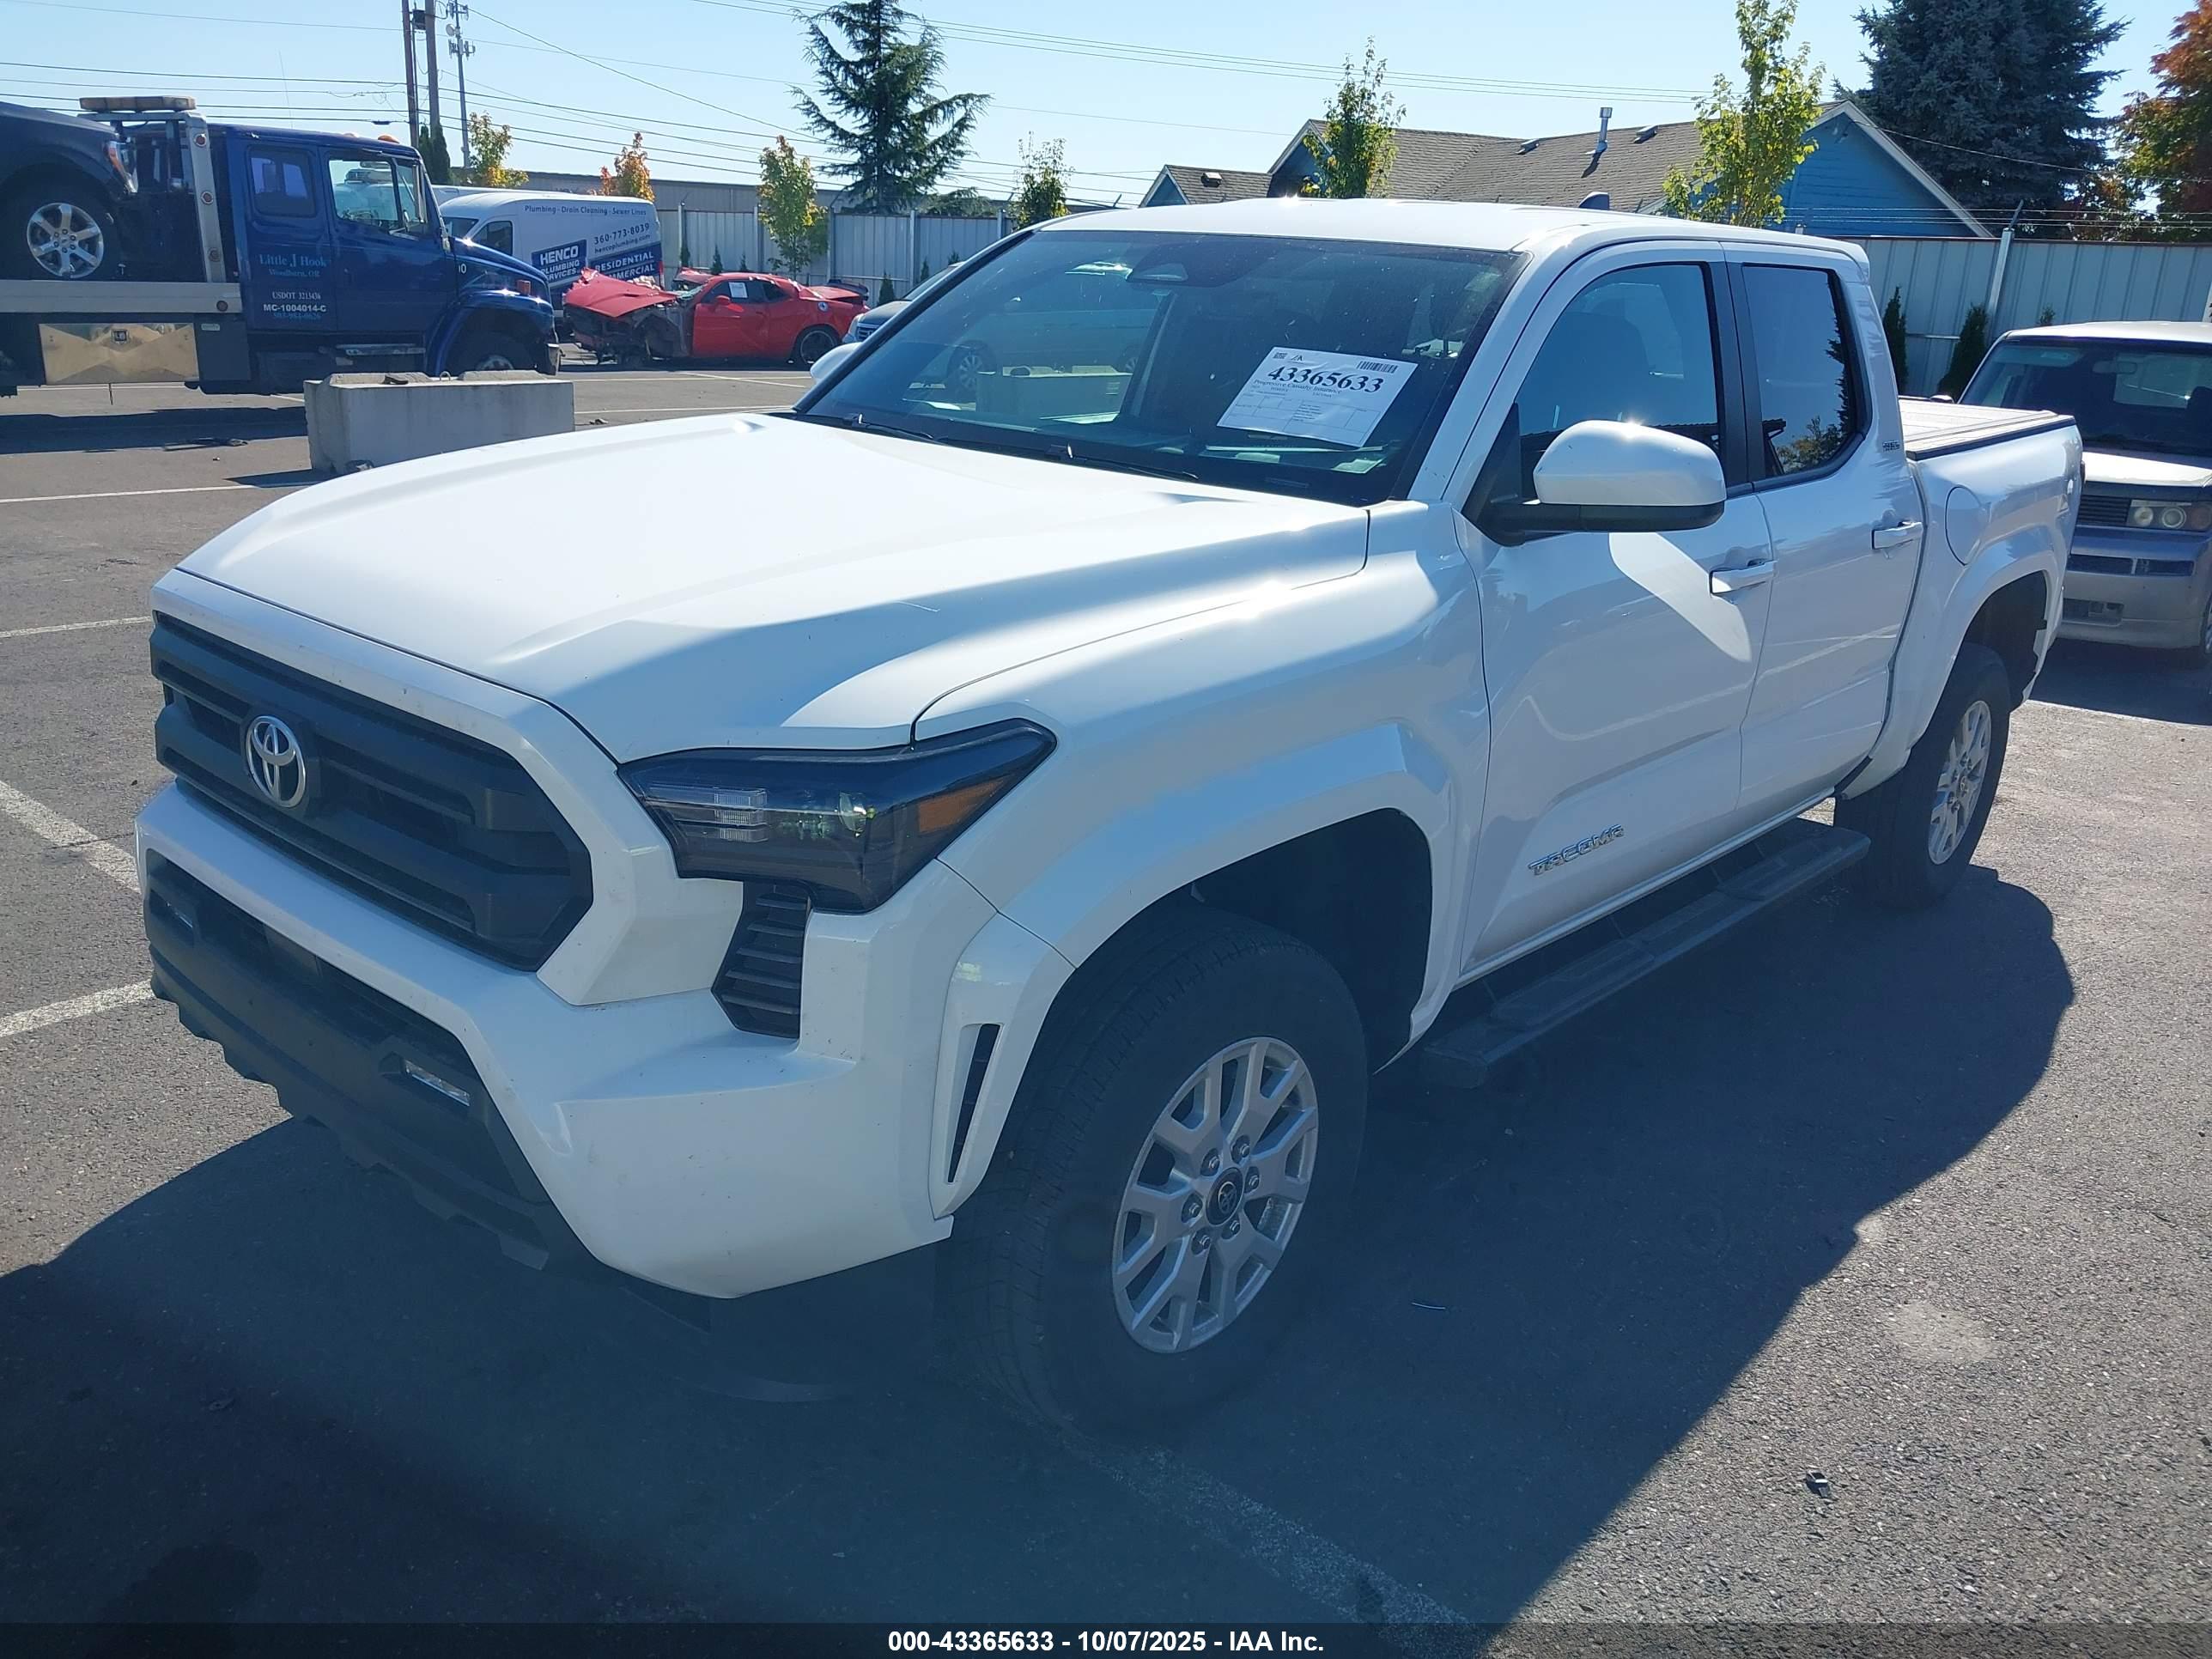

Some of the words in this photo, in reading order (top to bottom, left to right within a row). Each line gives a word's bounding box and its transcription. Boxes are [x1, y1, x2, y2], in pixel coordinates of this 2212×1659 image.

[525, 205, 556, 214] Plumbing
[580, 206, 608, 216] Cleaning
[259, 254, 288, 265] Little
[289, 253, 296, 267] J
[301, 255, 327, 267] Hook
[540, 246, 579, 265] HENCO
[595, 252, 654, 272] RESIDENTIAL
[272, 291, 295, 300] USDOT
[263, 304, 326, 313] MC-1004014-C
[1268, 366, 1384, 393] 43365633
[1528, 823, 1624, 876] TACOMA
